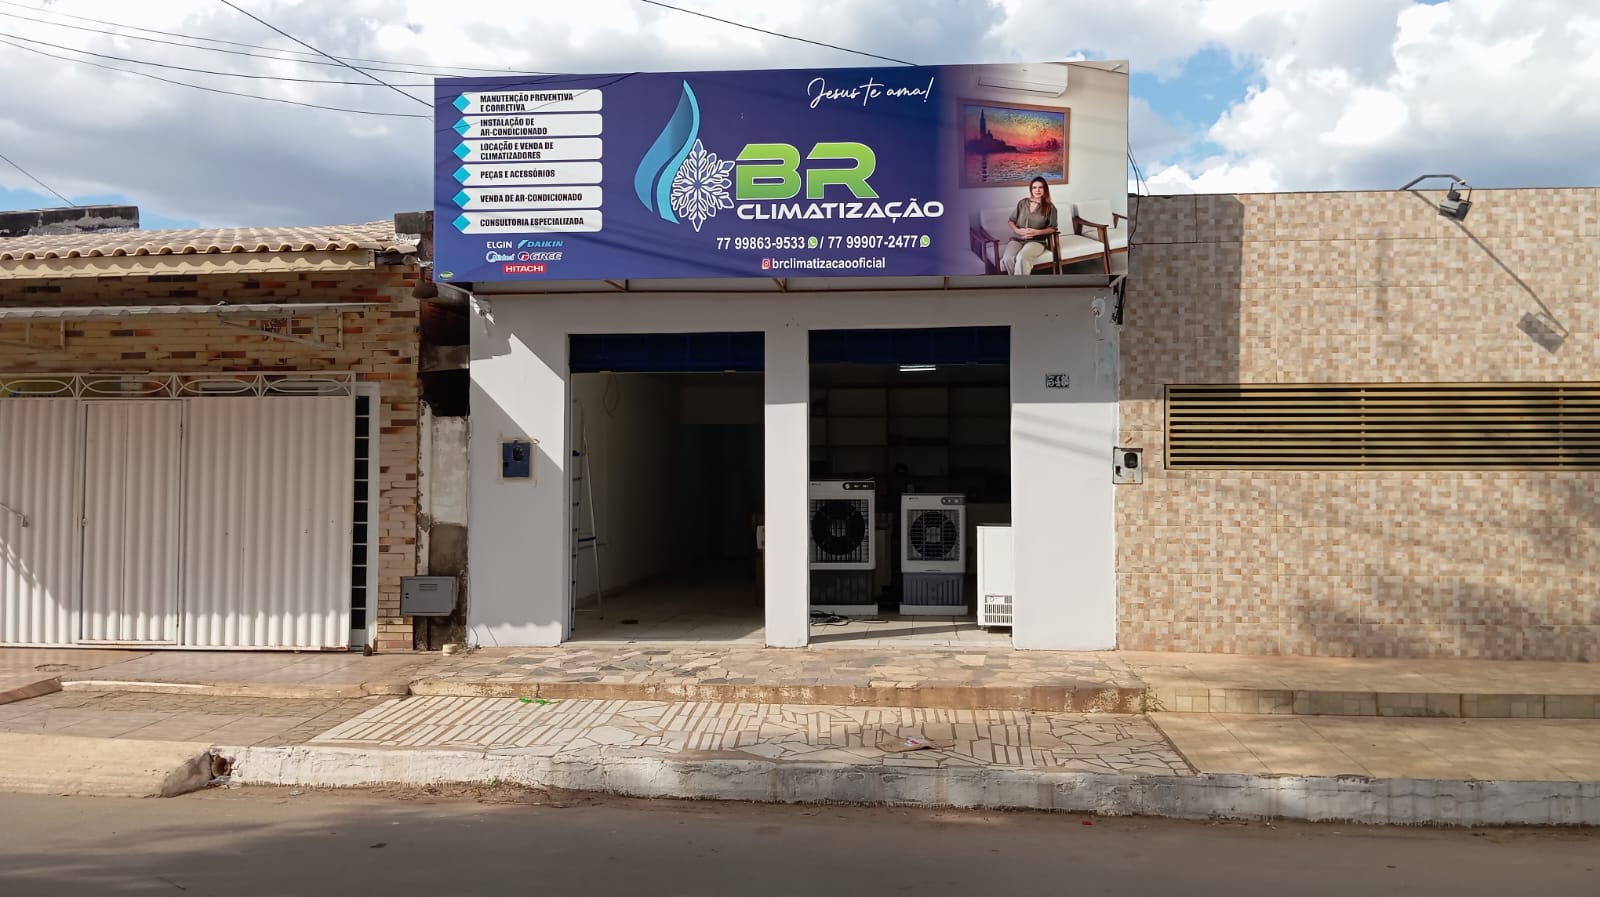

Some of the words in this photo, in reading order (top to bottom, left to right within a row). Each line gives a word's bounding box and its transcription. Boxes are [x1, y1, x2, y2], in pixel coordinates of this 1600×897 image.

[480, 93, 529, 104] MANUTENÇÃO
[530, 93, 574, 102] PREVENTIVA
[807, 77, 860, 109] Jesus
[859, 77, 885, 107] te
[480, 104, 485, 112] E
[485, 103, 526, 112] CORRETIVA
[480, 117, 525, 128] INSTALAÇÃO
[525, 118, 535, 126] DE
[480, 127, 548, 136] AR-CONDICIONADO
[480, 141, 513, 152] LOCAÇÃO
[514, 142, 519, 150] E
[519, 142, 543, 150] VENDA
[544, 142, 554, 150] DE
[480, 151, 541, 161] CLIMATIZADORES
[480, 170, 504, 180] PEÇAS
[504, 170, 509, 178] E
[509, 168, 556, 178] ACESSÓRIOS
[735, 142, 880, 201] BR
[480, 194, 504, 203] VENDA
[505, 194, 514, 202] DE
[515, 193, 583, 202] AR-CONDICIONADO
[736, 198, 944, 224] CLIMATIZAÇÃO
[480, 218, 529, 227] CONSULTORIA
[530, 217, 585, 226] ESPECIALIZADA
[486, 240, 513, 249] ELGIN
[527, 240, 564, 248] DAIKIN
[716, 237, 731, 250] 77
[734, 236, 806, 250] 99863-9533
[828, 236, 843, 249] 77
[846, 235, 918, 249] 99907-2477
[772, 257, 886, 269] brclimatizacaooficial
[505, 265, 544, 273] HITACHI
